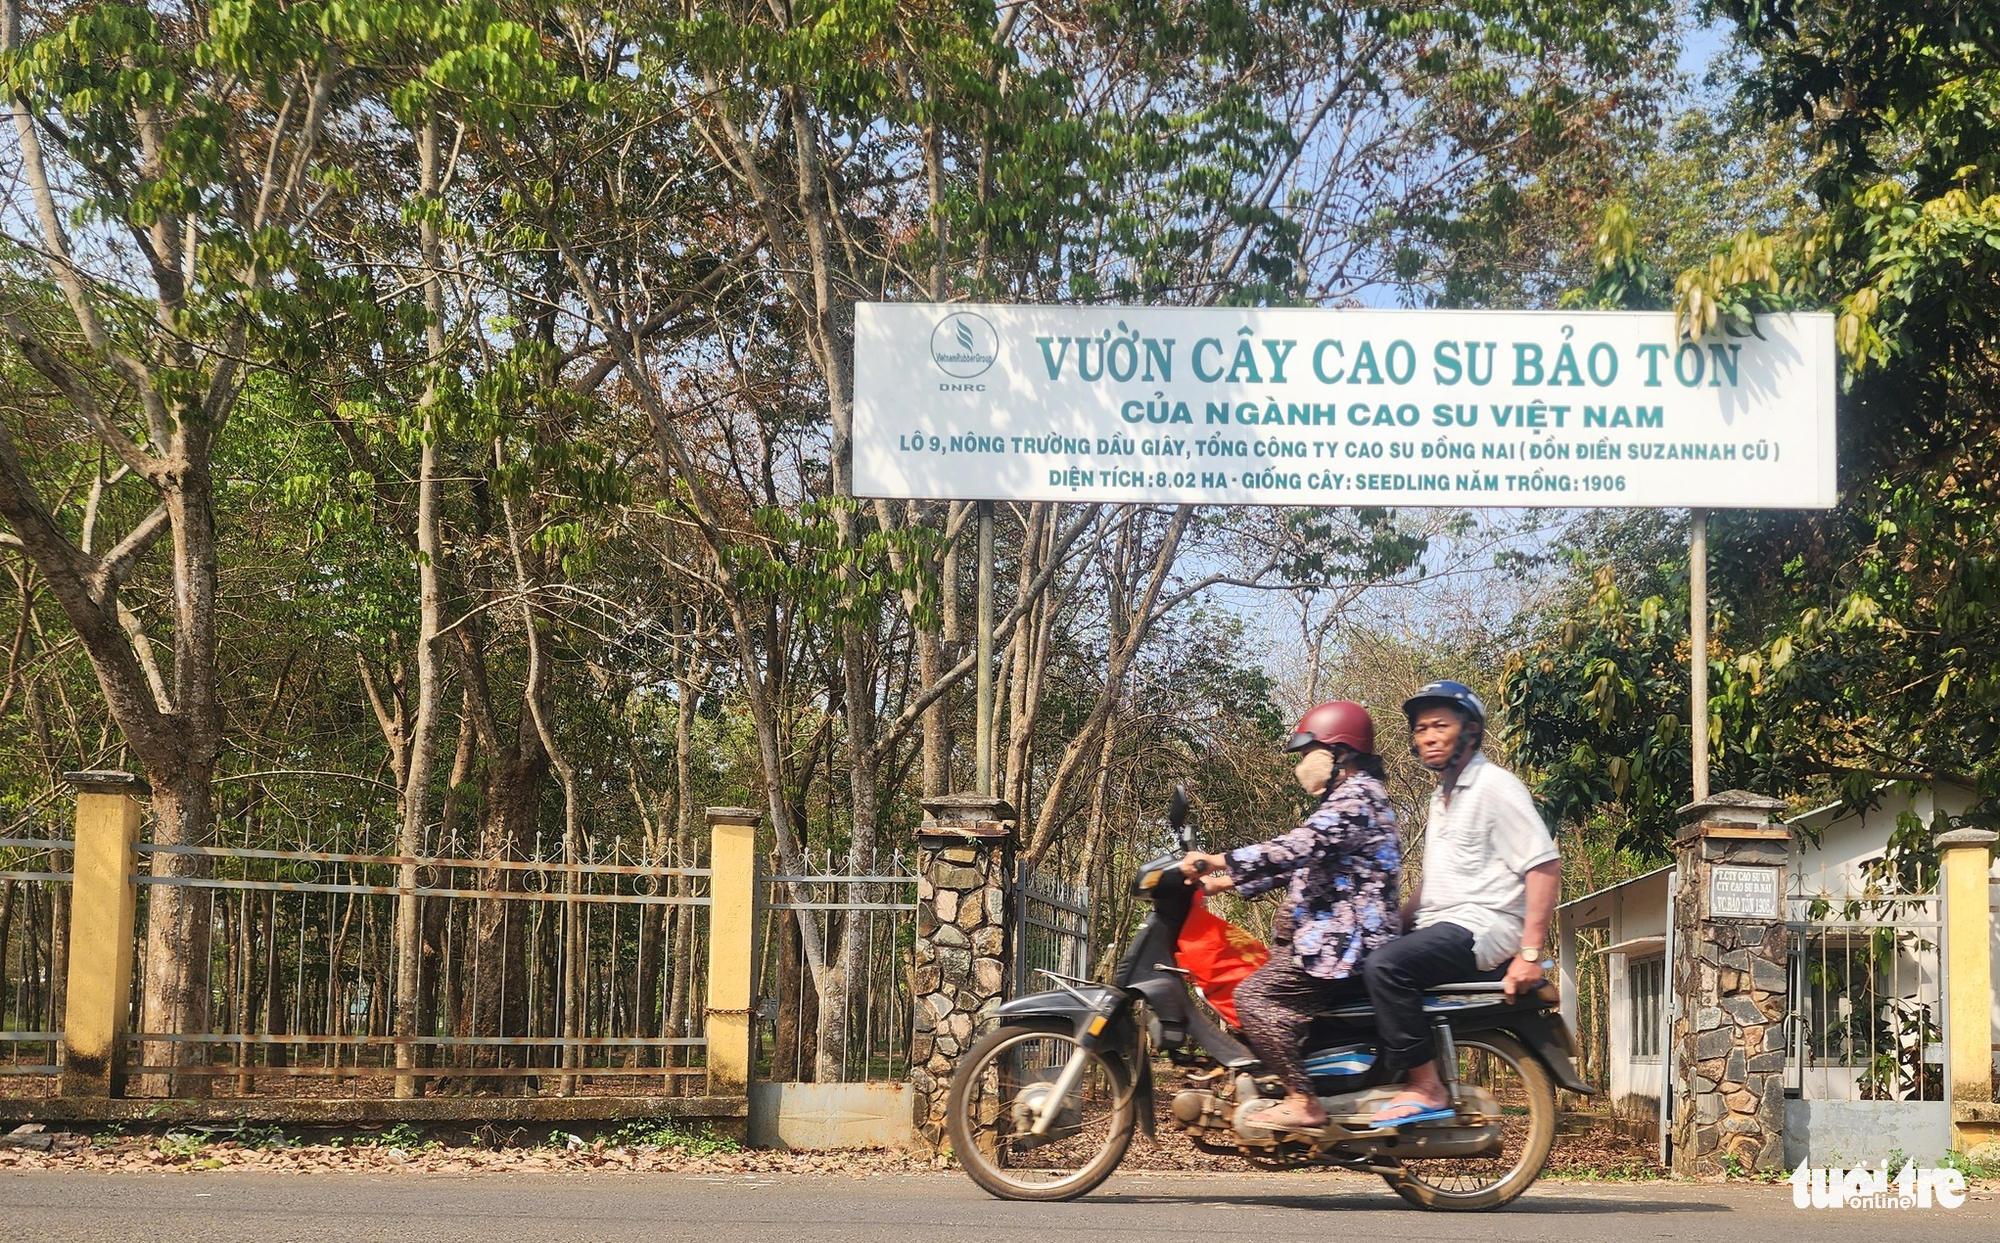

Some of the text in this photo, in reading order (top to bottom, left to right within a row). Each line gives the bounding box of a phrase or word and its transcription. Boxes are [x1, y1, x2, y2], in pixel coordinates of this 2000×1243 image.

[1036, 320, 1176, 384] VƯỜN
[1192, 326, 1298, 385] CÂY
[1313, 339, 1417, 386] CAO
[1434, 340, 1498, 387] SU
[1512, 325, 1619, 388] BẢO
[939, 383, 986, 392] DNRC
[1120, 391, 1664, 436] CỦA NGÀNH CAO SU VIỆT NAM
[900, 430, 925, 452] LÔ
[1011, 432, 1091, 456] TRƯỜNG
[1097, 431, 1135, 456] DẦU
[1195, 430, 1248, 457] TỔNG
[1254, 436, 1308, 458] CÔNG
[1313, 442, 1339, 458] TY
[1345, 442, 1384, 459] CAO
[1390, 442, 1415, 459] SU
[1421, 434, 1476, 460] ĐỒNG
[1482, 443, 1515, 460] NAI
[1576, 437, 1622, 461] ĐIỀN
[1628, 443, 1737, 461] SUZANNAH
[1049, 466, 1094, 491] DIỆN
[1202, 472, 1228, 489] HA
[1242, 465, 1302, 490] GIỐNG
[1356, 474, 1451, 491] SEEDLING
[1456, 469, 1499, 491] NĂM
[1717, 881, 1730, 891] CTY
[1730, 882, 1743, 892] CAO
[1744, 883, 1753, 892] SU
[1738, 872, 1751, 882] CAO
[1752, 873, 1761, 882] SU
